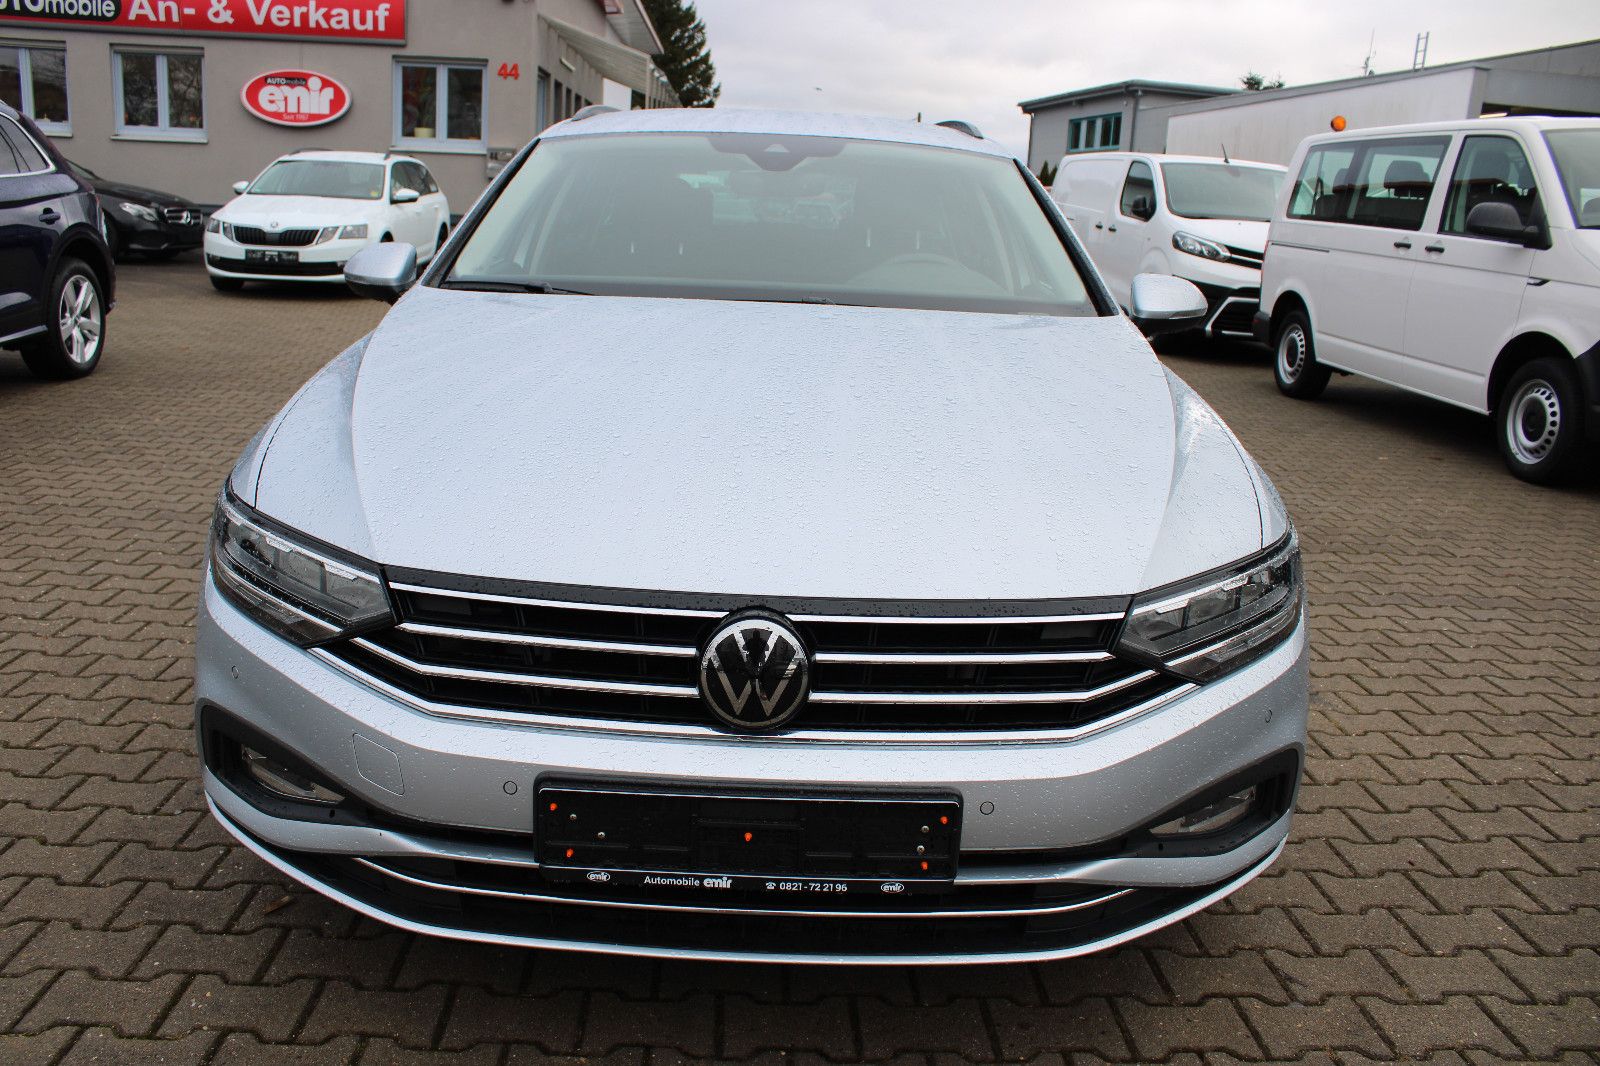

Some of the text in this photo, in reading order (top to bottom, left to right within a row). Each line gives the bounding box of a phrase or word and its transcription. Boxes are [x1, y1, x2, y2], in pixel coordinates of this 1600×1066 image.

[128, 0, 196, 22] An-
[207, 0, 235, 24] &
[247, 0, 391, 31] Verkauf
[497, 63, 519, 80] 44
[258, 76, 334, 114] emir
[589, 872, 609, 881] emir
[644, 876, 732, 889] Automobile emir
[883, 882, 902, 893] emir
